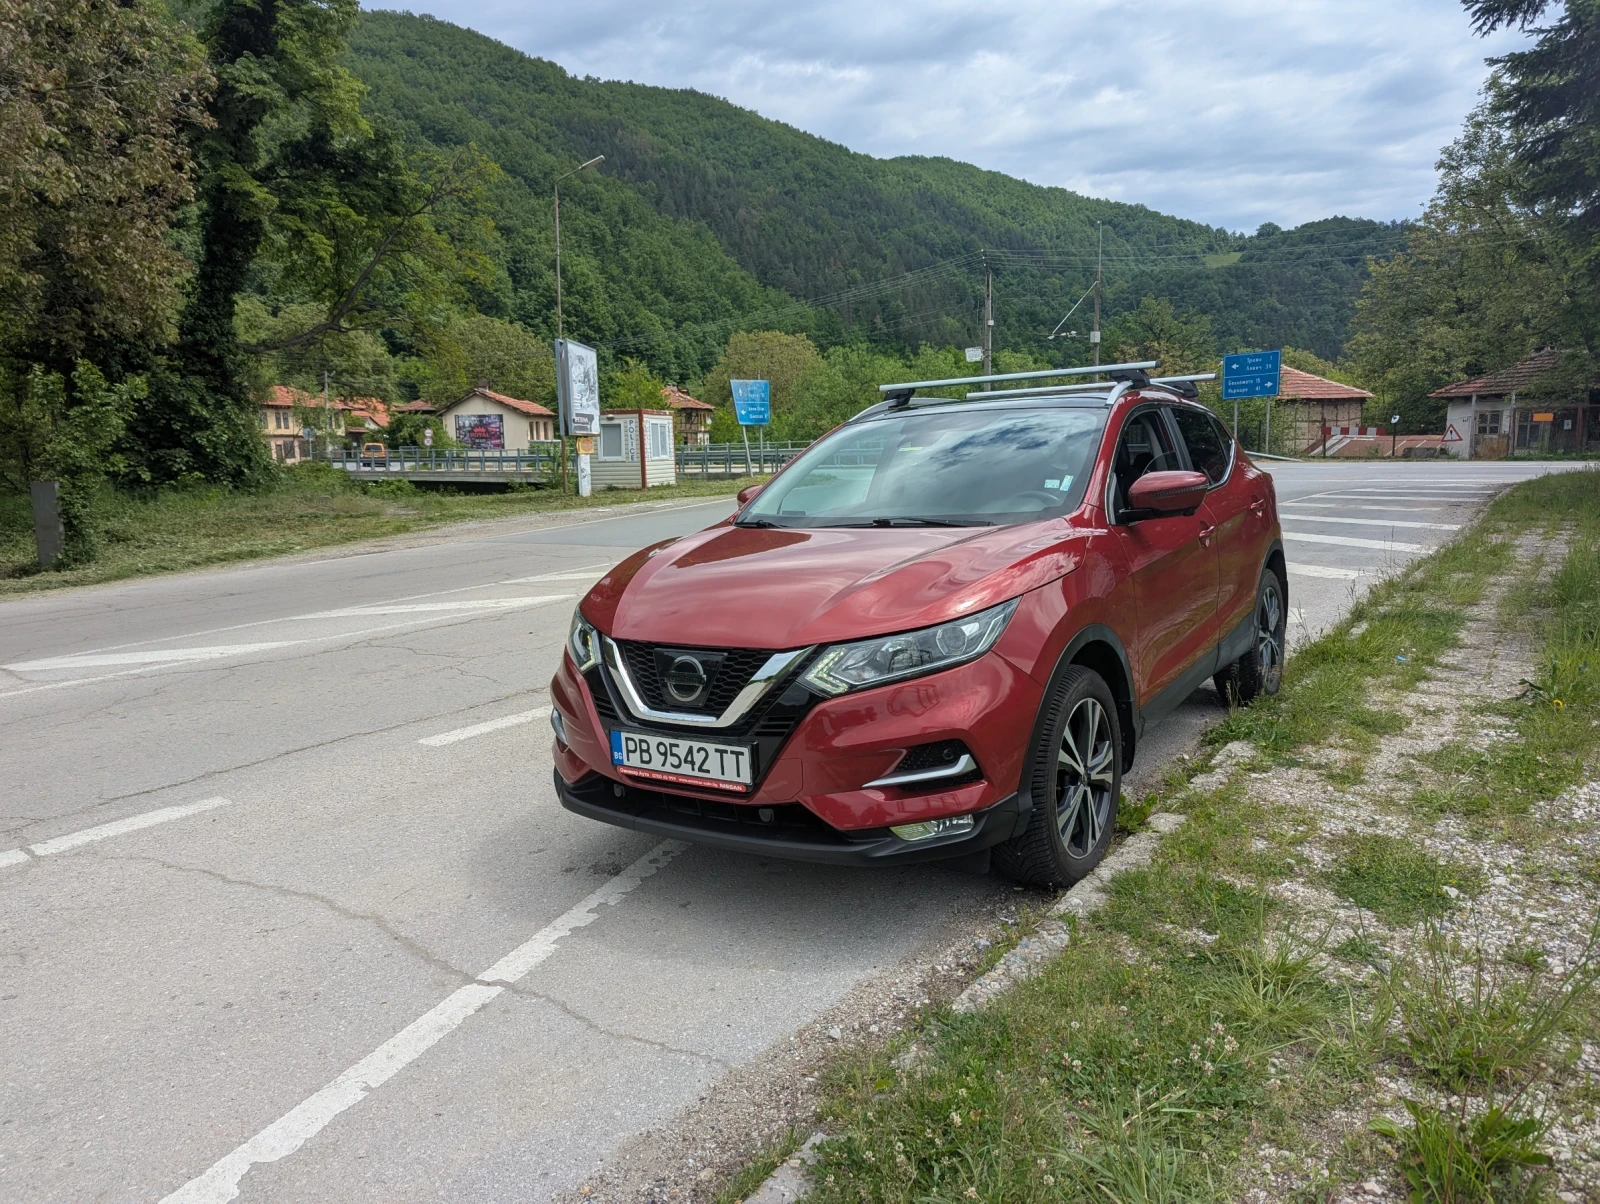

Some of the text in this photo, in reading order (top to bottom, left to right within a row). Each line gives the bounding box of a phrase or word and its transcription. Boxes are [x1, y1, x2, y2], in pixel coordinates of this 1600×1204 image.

[613, 751, 623, 760] BG
[625, 736, 745, 778] PB 9542 TT
[719, 783, 742, 791] NISSAN
